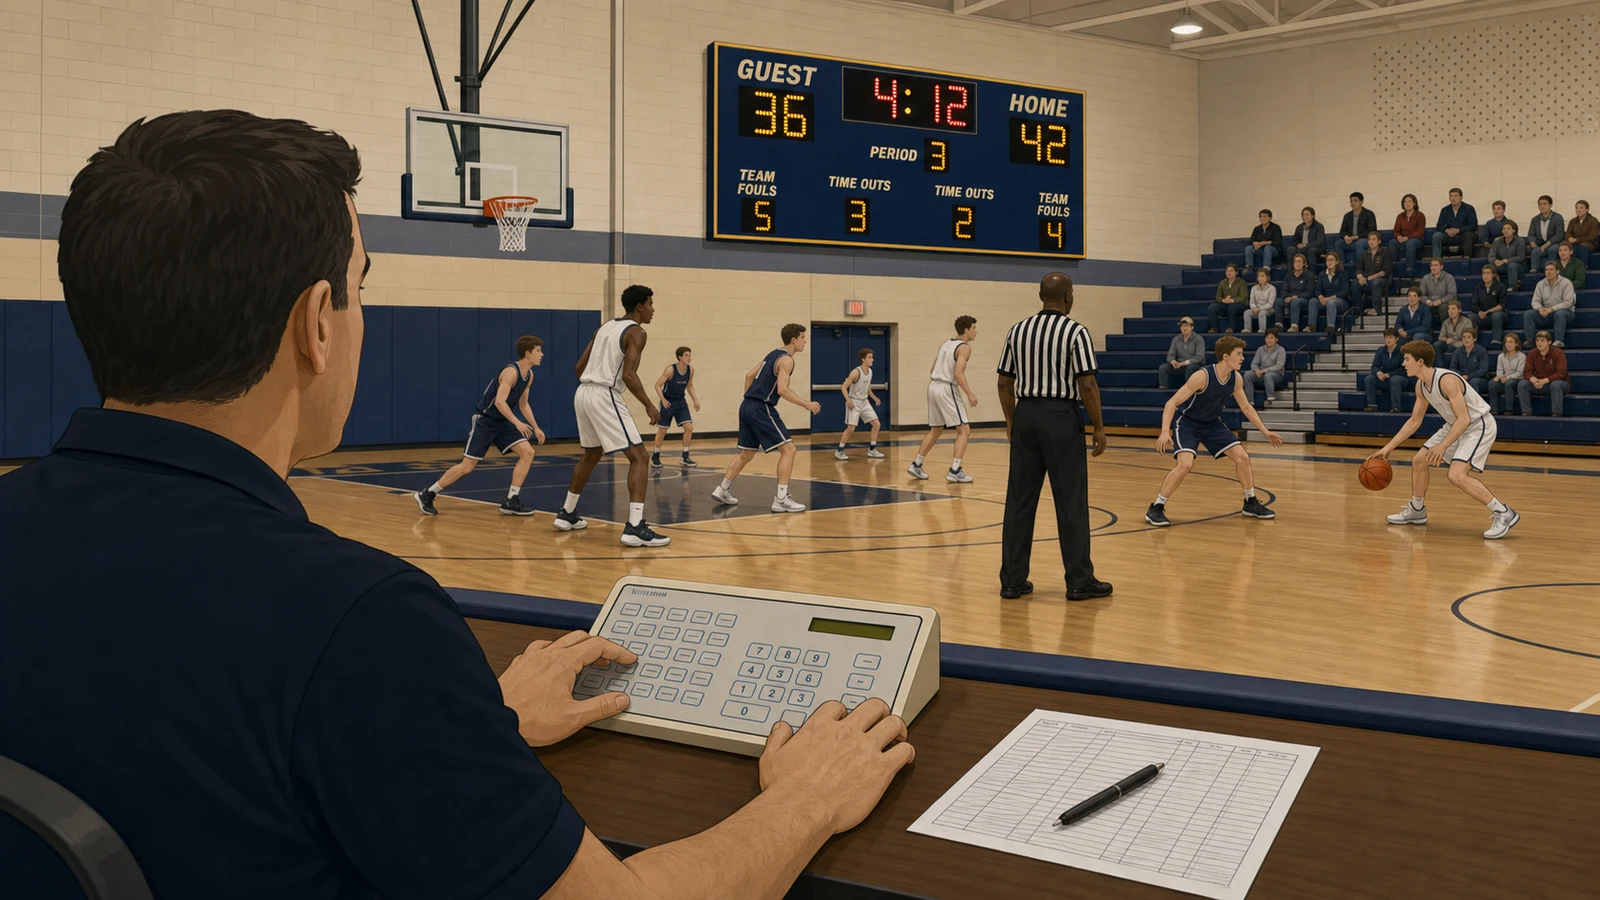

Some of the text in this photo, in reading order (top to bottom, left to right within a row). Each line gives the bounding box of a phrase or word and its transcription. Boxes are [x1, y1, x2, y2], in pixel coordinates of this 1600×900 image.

[737, 59, 818, 87] GUEST
[873, 77, 968, 127] 4:12
[1009, 93, 1070, 118] HOME
[754, 91, 807, 138] 36
[1020, 123, 1067, 165] 42
[869, 146, 918, 162] PERIOD
[930, 141, 946, 171] 3
[739, 169, 776, 183] TEAM
[828, 176, 891, 192] TIME OUTS
[737, 182, 777, 197] FOULS
[934, 185, 995, 200] TIME OUTS
[1038, 192, 1069, 205] TEAM
[754, 200, 771, 232] 5
[850, 199, 866, 232] 3
[1037, 205, 1070, 218] FOULS
[955, 206, 973, 239] 2
[1047, 222, 1062, 249] 4
[757, 647, 820, 663] 7 8 9
[748, 666, 755, 674] 4
[805, 674, 812, 683] 6
[741, 685, 805, 702] 1 2 3
[740, 706, 748, 716] 0
